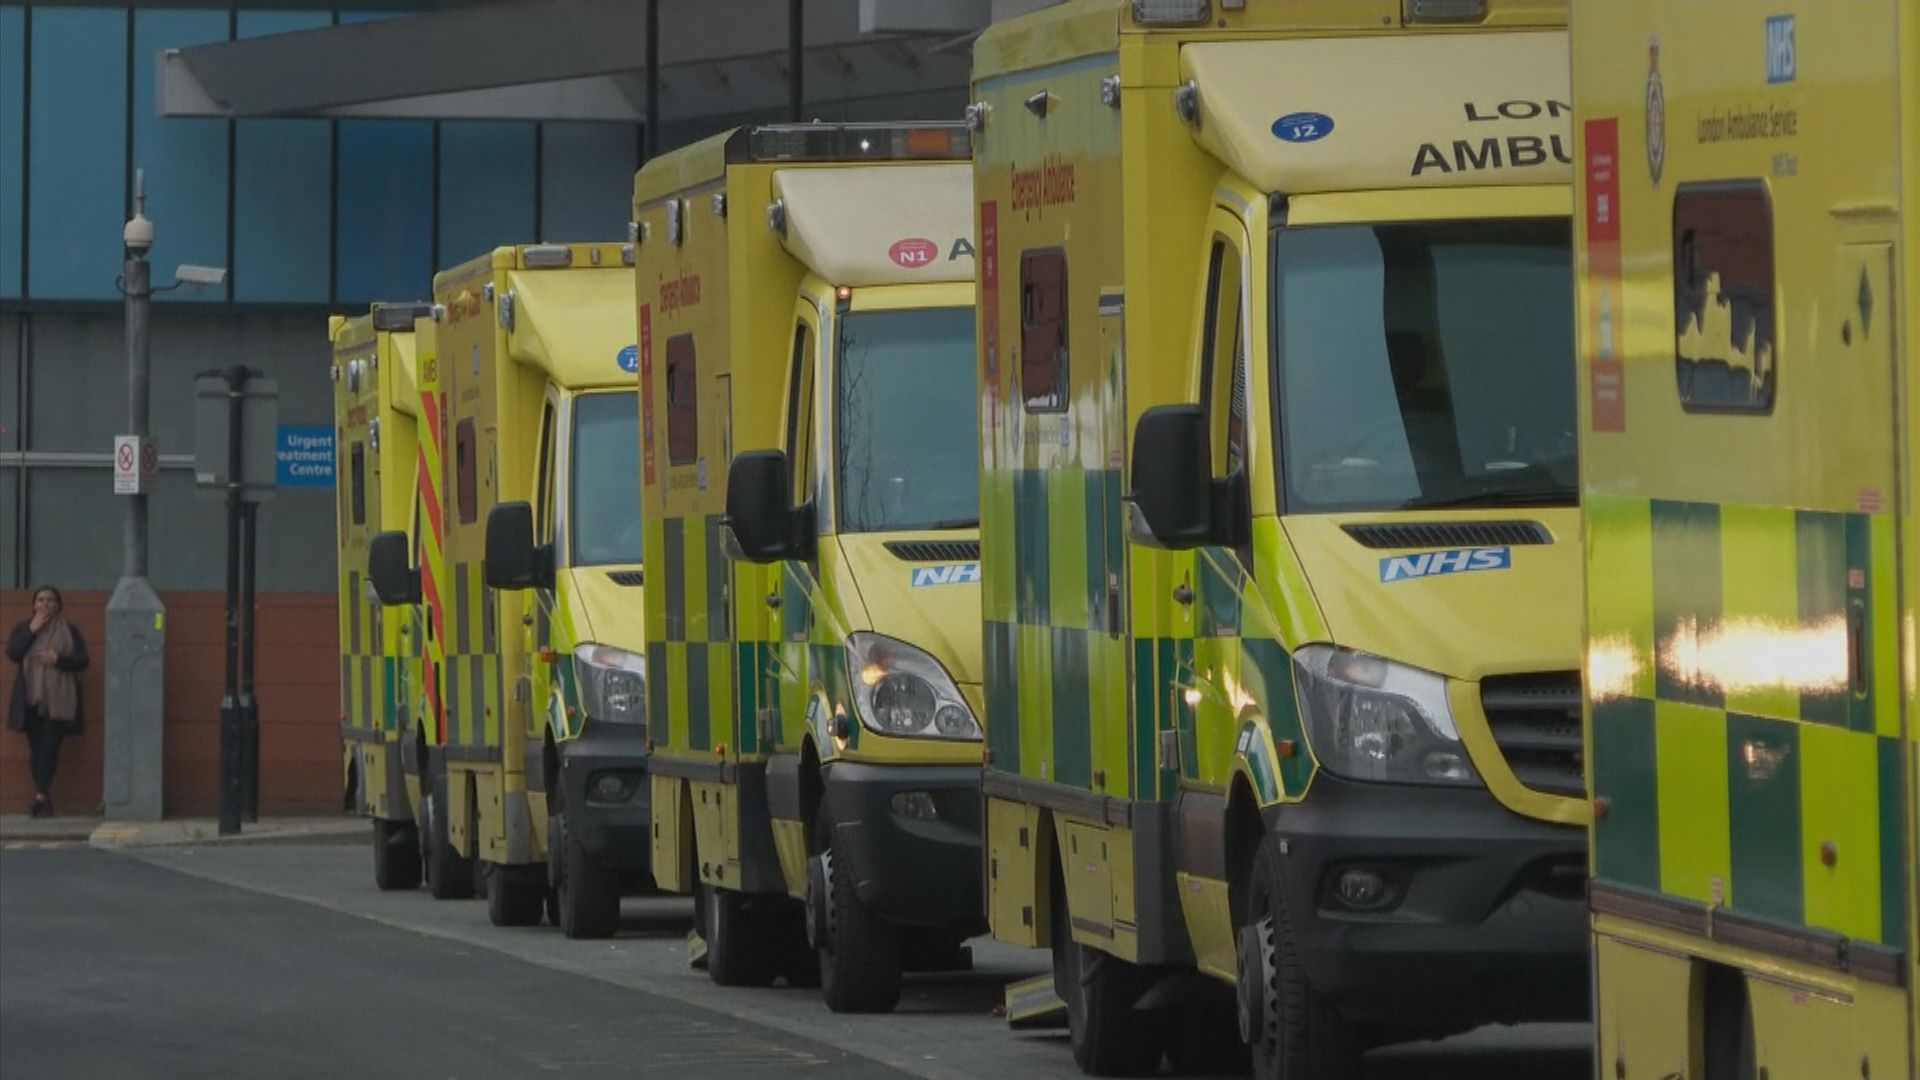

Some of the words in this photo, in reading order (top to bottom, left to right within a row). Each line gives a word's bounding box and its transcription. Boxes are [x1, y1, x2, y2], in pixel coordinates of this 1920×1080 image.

[1767, 19, 1795, 80] NHS
[1292, 124, 1318, 139] J2
[1697, 108, 1725, 145] London
[1727, 103, 1769, 141] Ambulance
[1769, 100, 1798, 138] Service
[1011, 160, 1041, 223] Emergency
[1042, 152, 1075, 207] Ambulance
[900, 249, 928, 264] N1
[287, 434, 333, 449] Urgent
[289, 463, 333, 476] Centre
[1384, 548, 1505, 581] NHS
